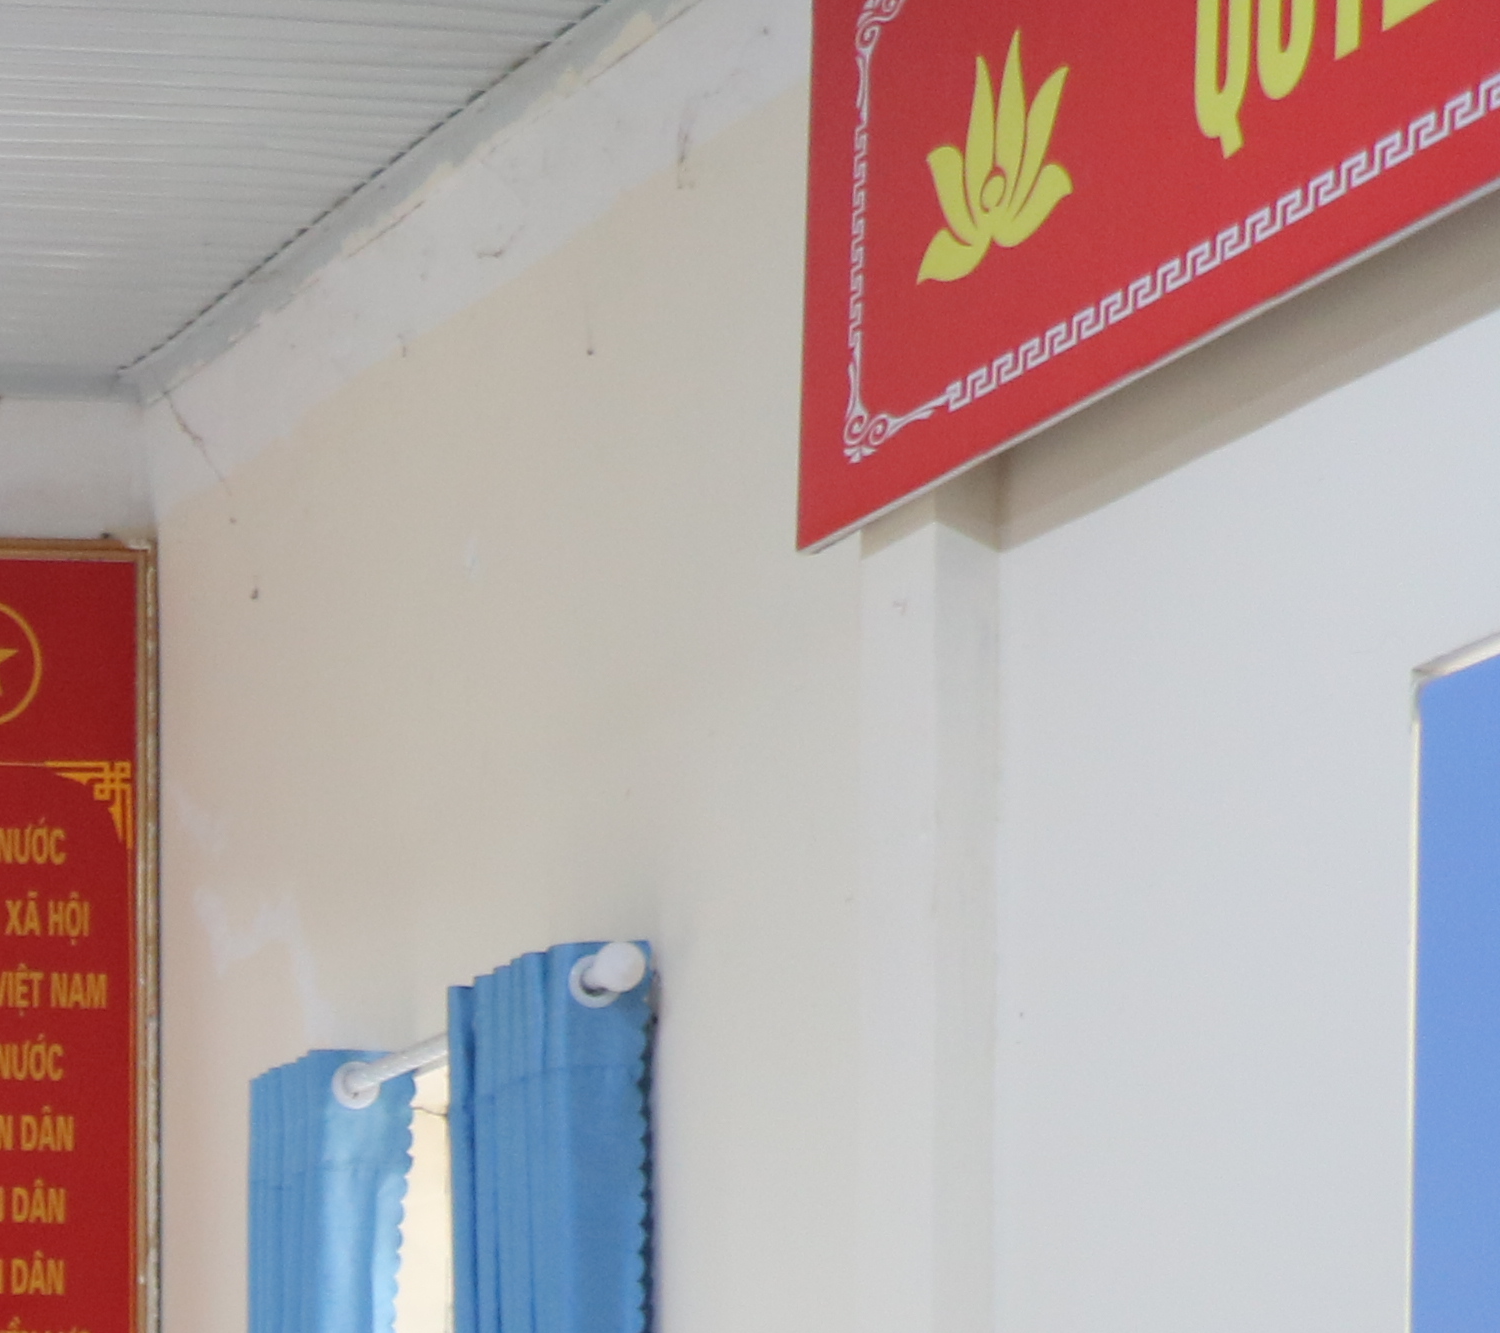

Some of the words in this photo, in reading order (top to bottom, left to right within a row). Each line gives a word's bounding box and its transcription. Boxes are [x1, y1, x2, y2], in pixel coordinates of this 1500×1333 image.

[5, 891, 41, 936] XÃ
[48, 891, 91, 946] HỘI
[50, 973, 108, 1009] NAM
[21, 1105, 75, 1152] DÂN
[12, 1179, 67, 1224] DÂN
[11, 1250, 66, 1296] DÂN
